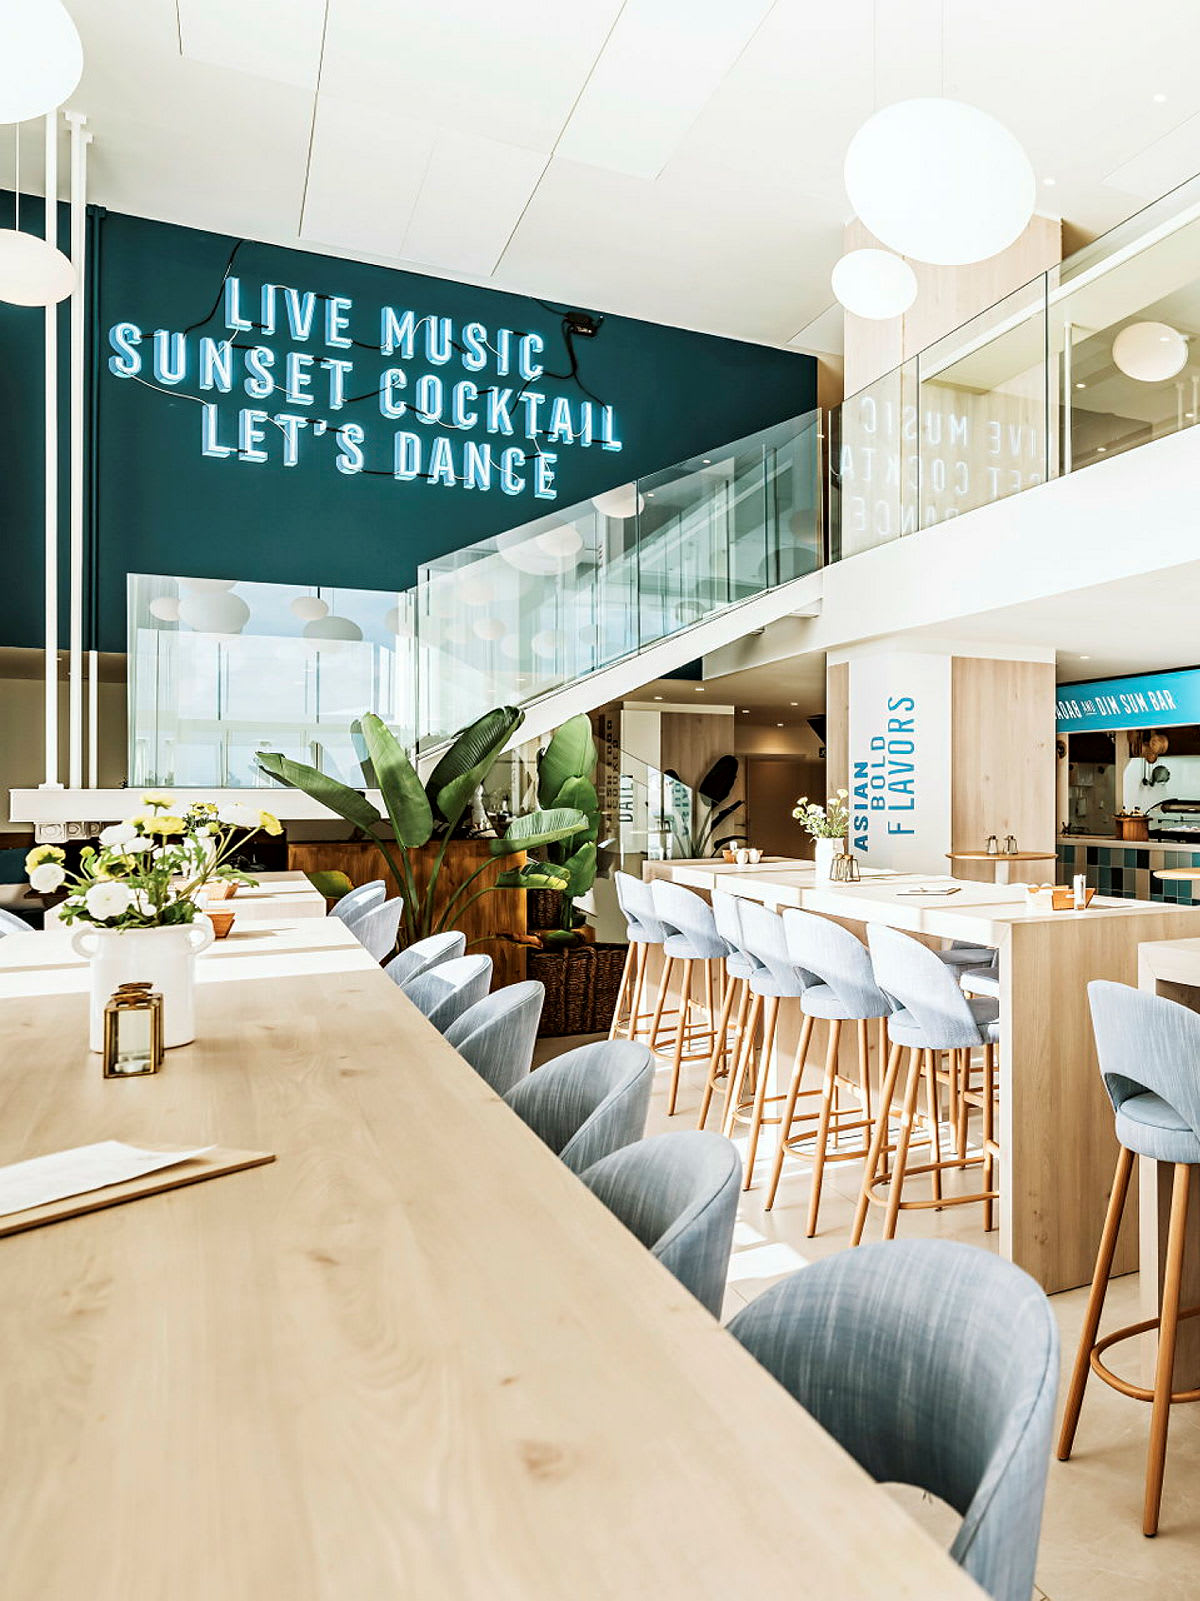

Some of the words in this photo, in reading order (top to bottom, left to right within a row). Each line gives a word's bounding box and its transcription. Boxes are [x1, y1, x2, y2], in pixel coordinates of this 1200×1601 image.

[224, 276, 353, 349] LIVE
[380, 305, 545, 381] MUSIC
[108, 322, 354, 410] SUNSET
[379, 367, 622, 452] COCKTAIL
[202, 403, 365, 475] LET'S
[393, 430, 558, 499] DANCE
[1095, 695, 1121, 716] DIM
[1120, 692, 1149, 714] SUM
[1147, 690, 1177, 711] BAR
[854, 761, 869, 852] ASIAN
[871, 736, 886, 811] BOLD
[888, 697, 915, 835] FLAVORS
